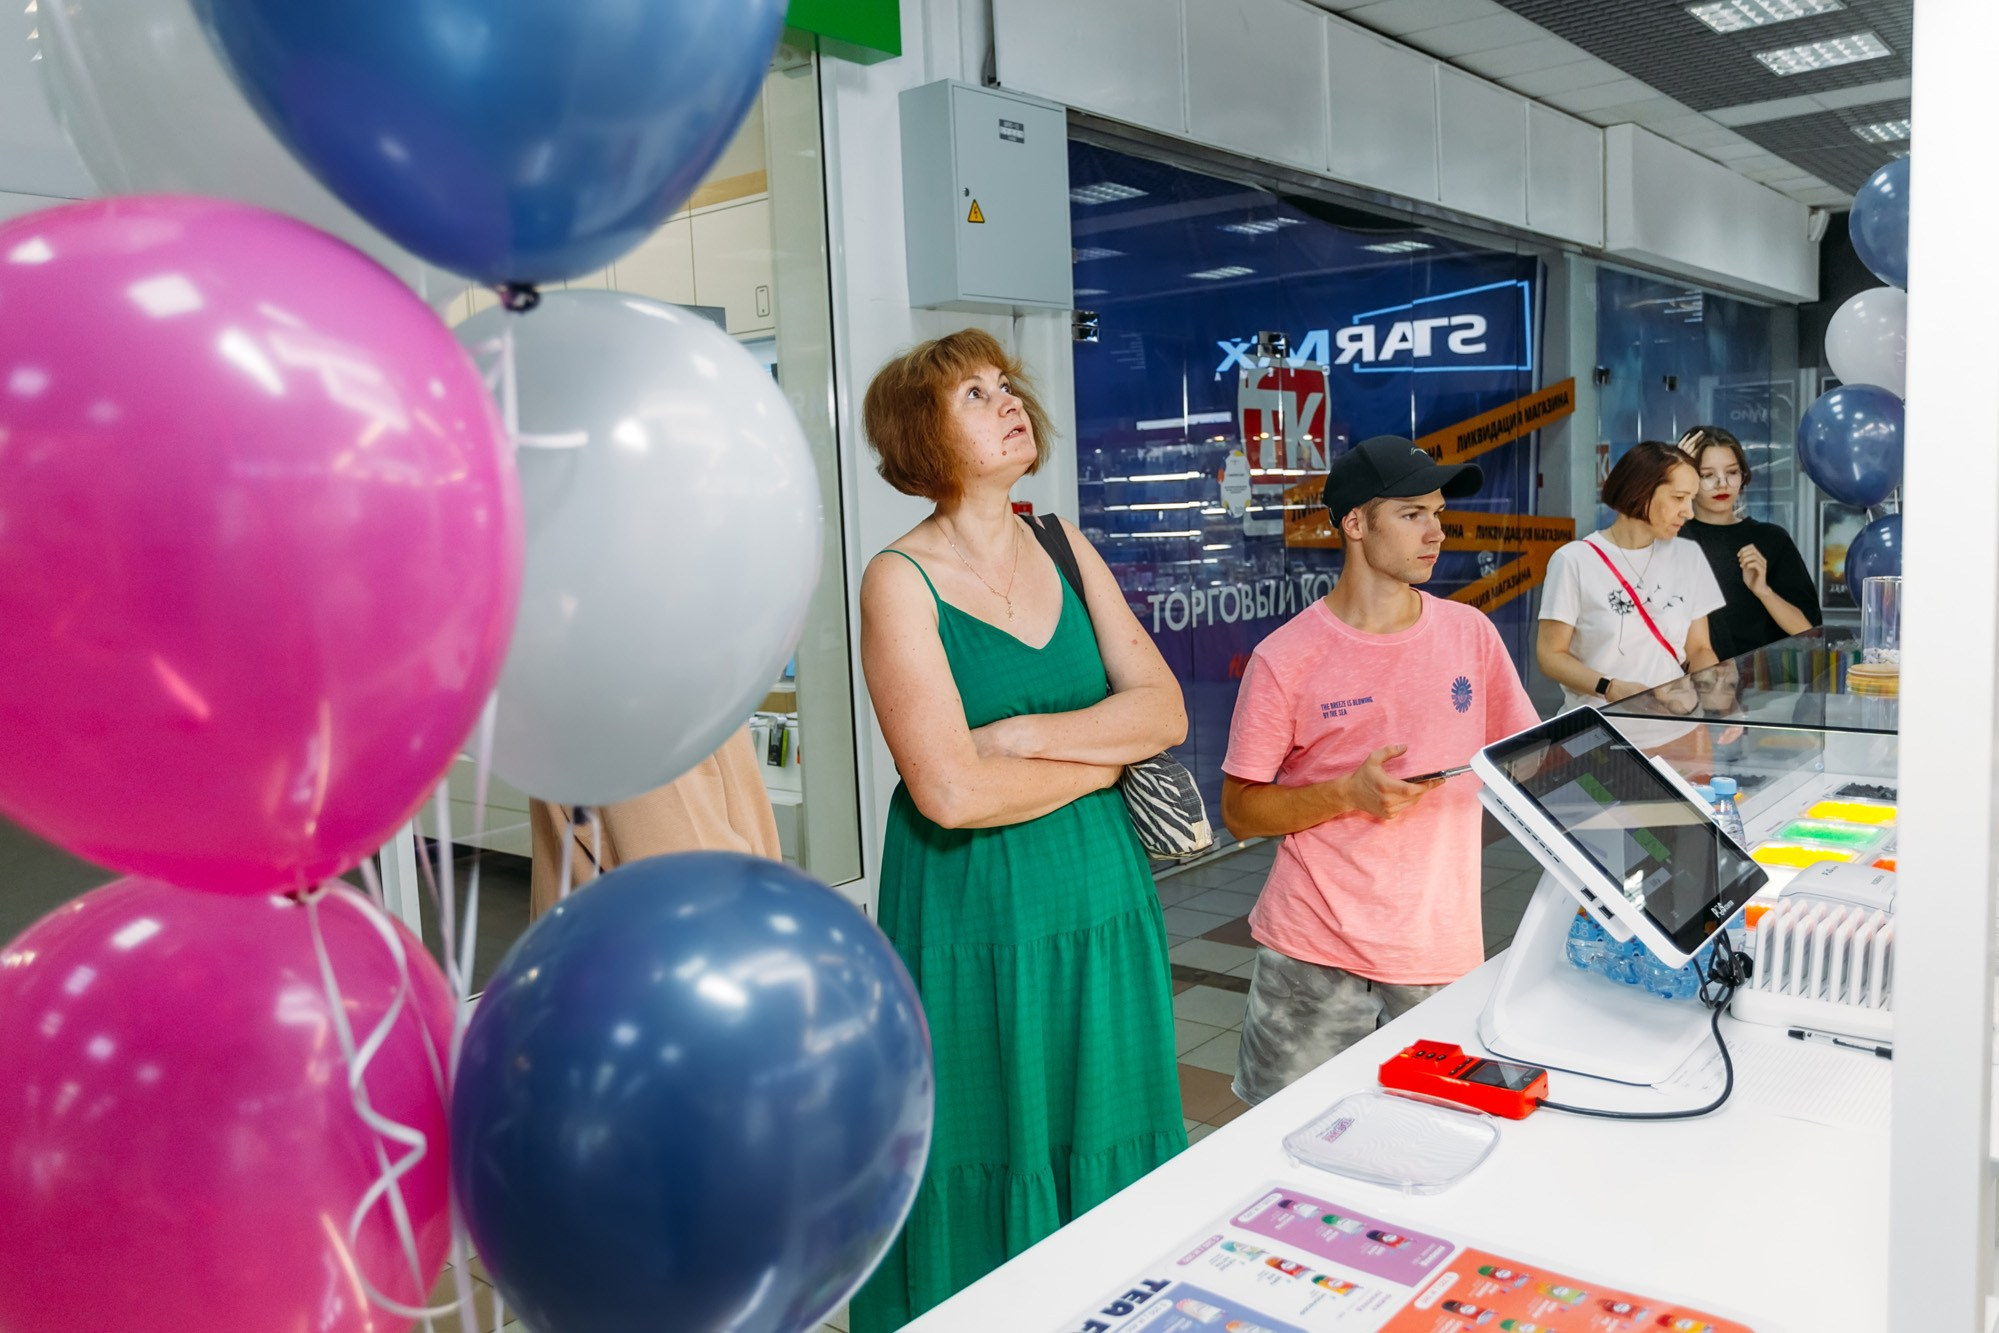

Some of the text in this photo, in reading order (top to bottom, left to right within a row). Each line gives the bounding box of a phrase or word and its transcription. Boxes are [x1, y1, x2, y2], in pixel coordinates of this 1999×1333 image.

[1456, 411, 1524, 454] ЛИКВИДАЦИЯ
[1524, 391, 1569, 424] МАГАЗИНА
[1475, 524, 1533, 544] ЛИКВИДАЦИЯ
[1534, 528, 1572, 541] МАГАЗИНА
[1301, 573, 1338, 608] КО
[1490, 566, 1532, 599] МАГАЗИНА
[1101, 1277, 1172, 1317] TEA
